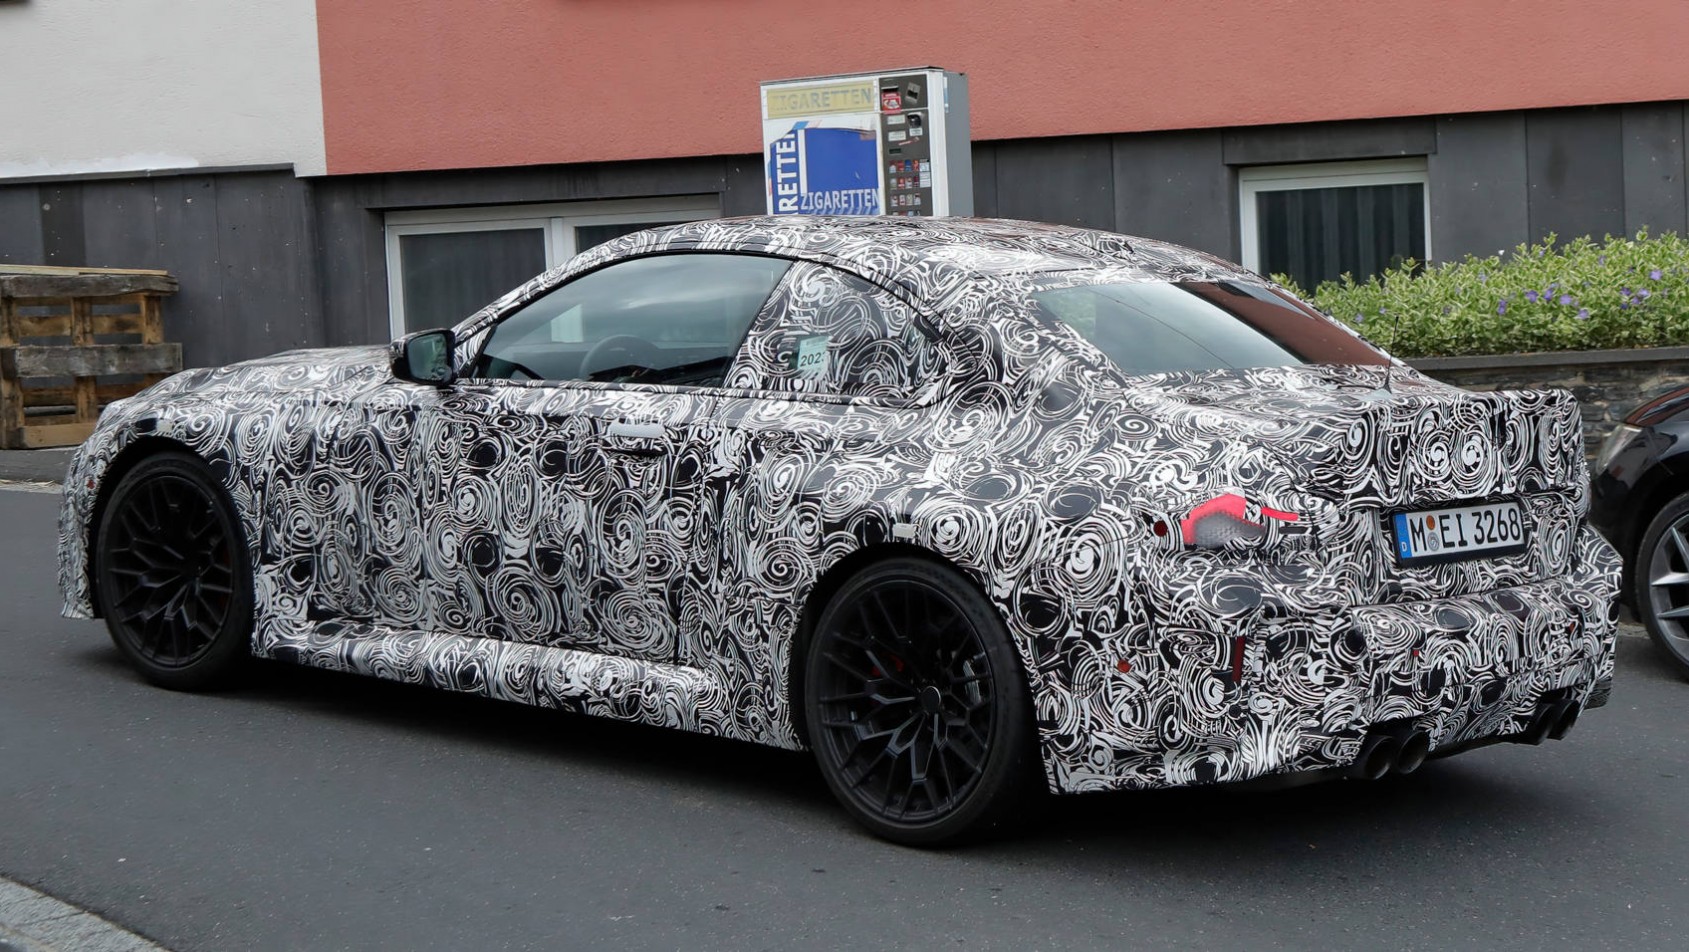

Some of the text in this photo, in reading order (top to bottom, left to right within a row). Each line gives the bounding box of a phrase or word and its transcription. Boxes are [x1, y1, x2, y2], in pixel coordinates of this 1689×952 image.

[800, 188, 879, 210] ZIGARETTEN
[1409, 508, 1521, 552] M EI 3268
[1401, 543, 1407, 552] D
